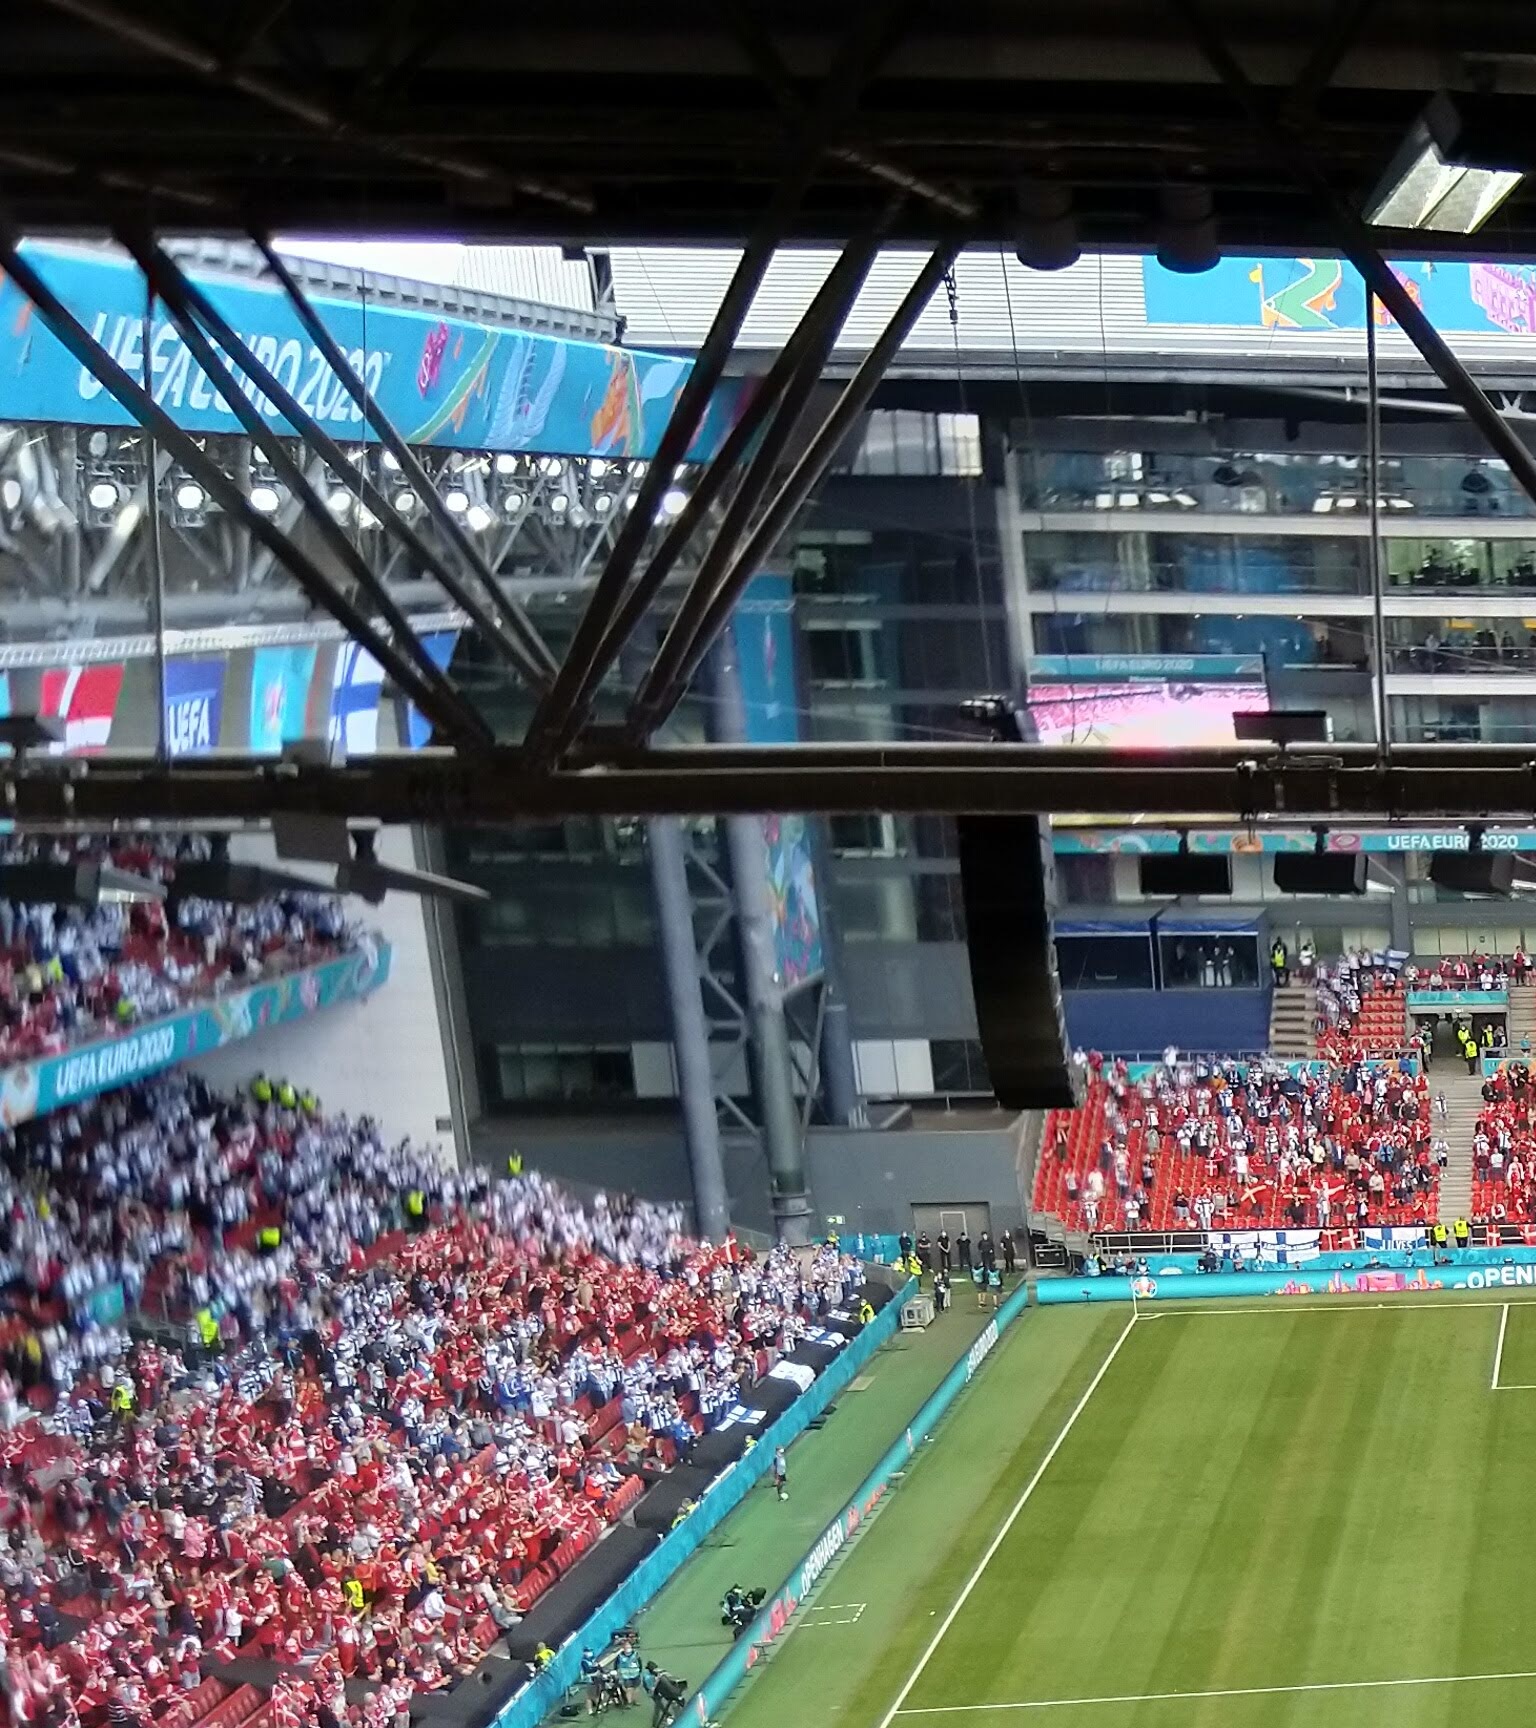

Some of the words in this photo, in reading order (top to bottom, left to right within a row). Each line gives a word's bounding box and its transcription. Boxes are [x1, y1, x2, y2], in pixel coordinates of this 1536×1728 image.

[168, 698, 210, 755] UEFA
[1388, 835, 1430, 849] UEFA
[1481, 834, 1518, 848] 2020
[56, 1051, 97, 1099] UEFA
[98, 1038, 139, 1083] EURO
[138, 1025, 175, 1069] 2020
[799, 1519, 844, 1601] OPENHAGEN
